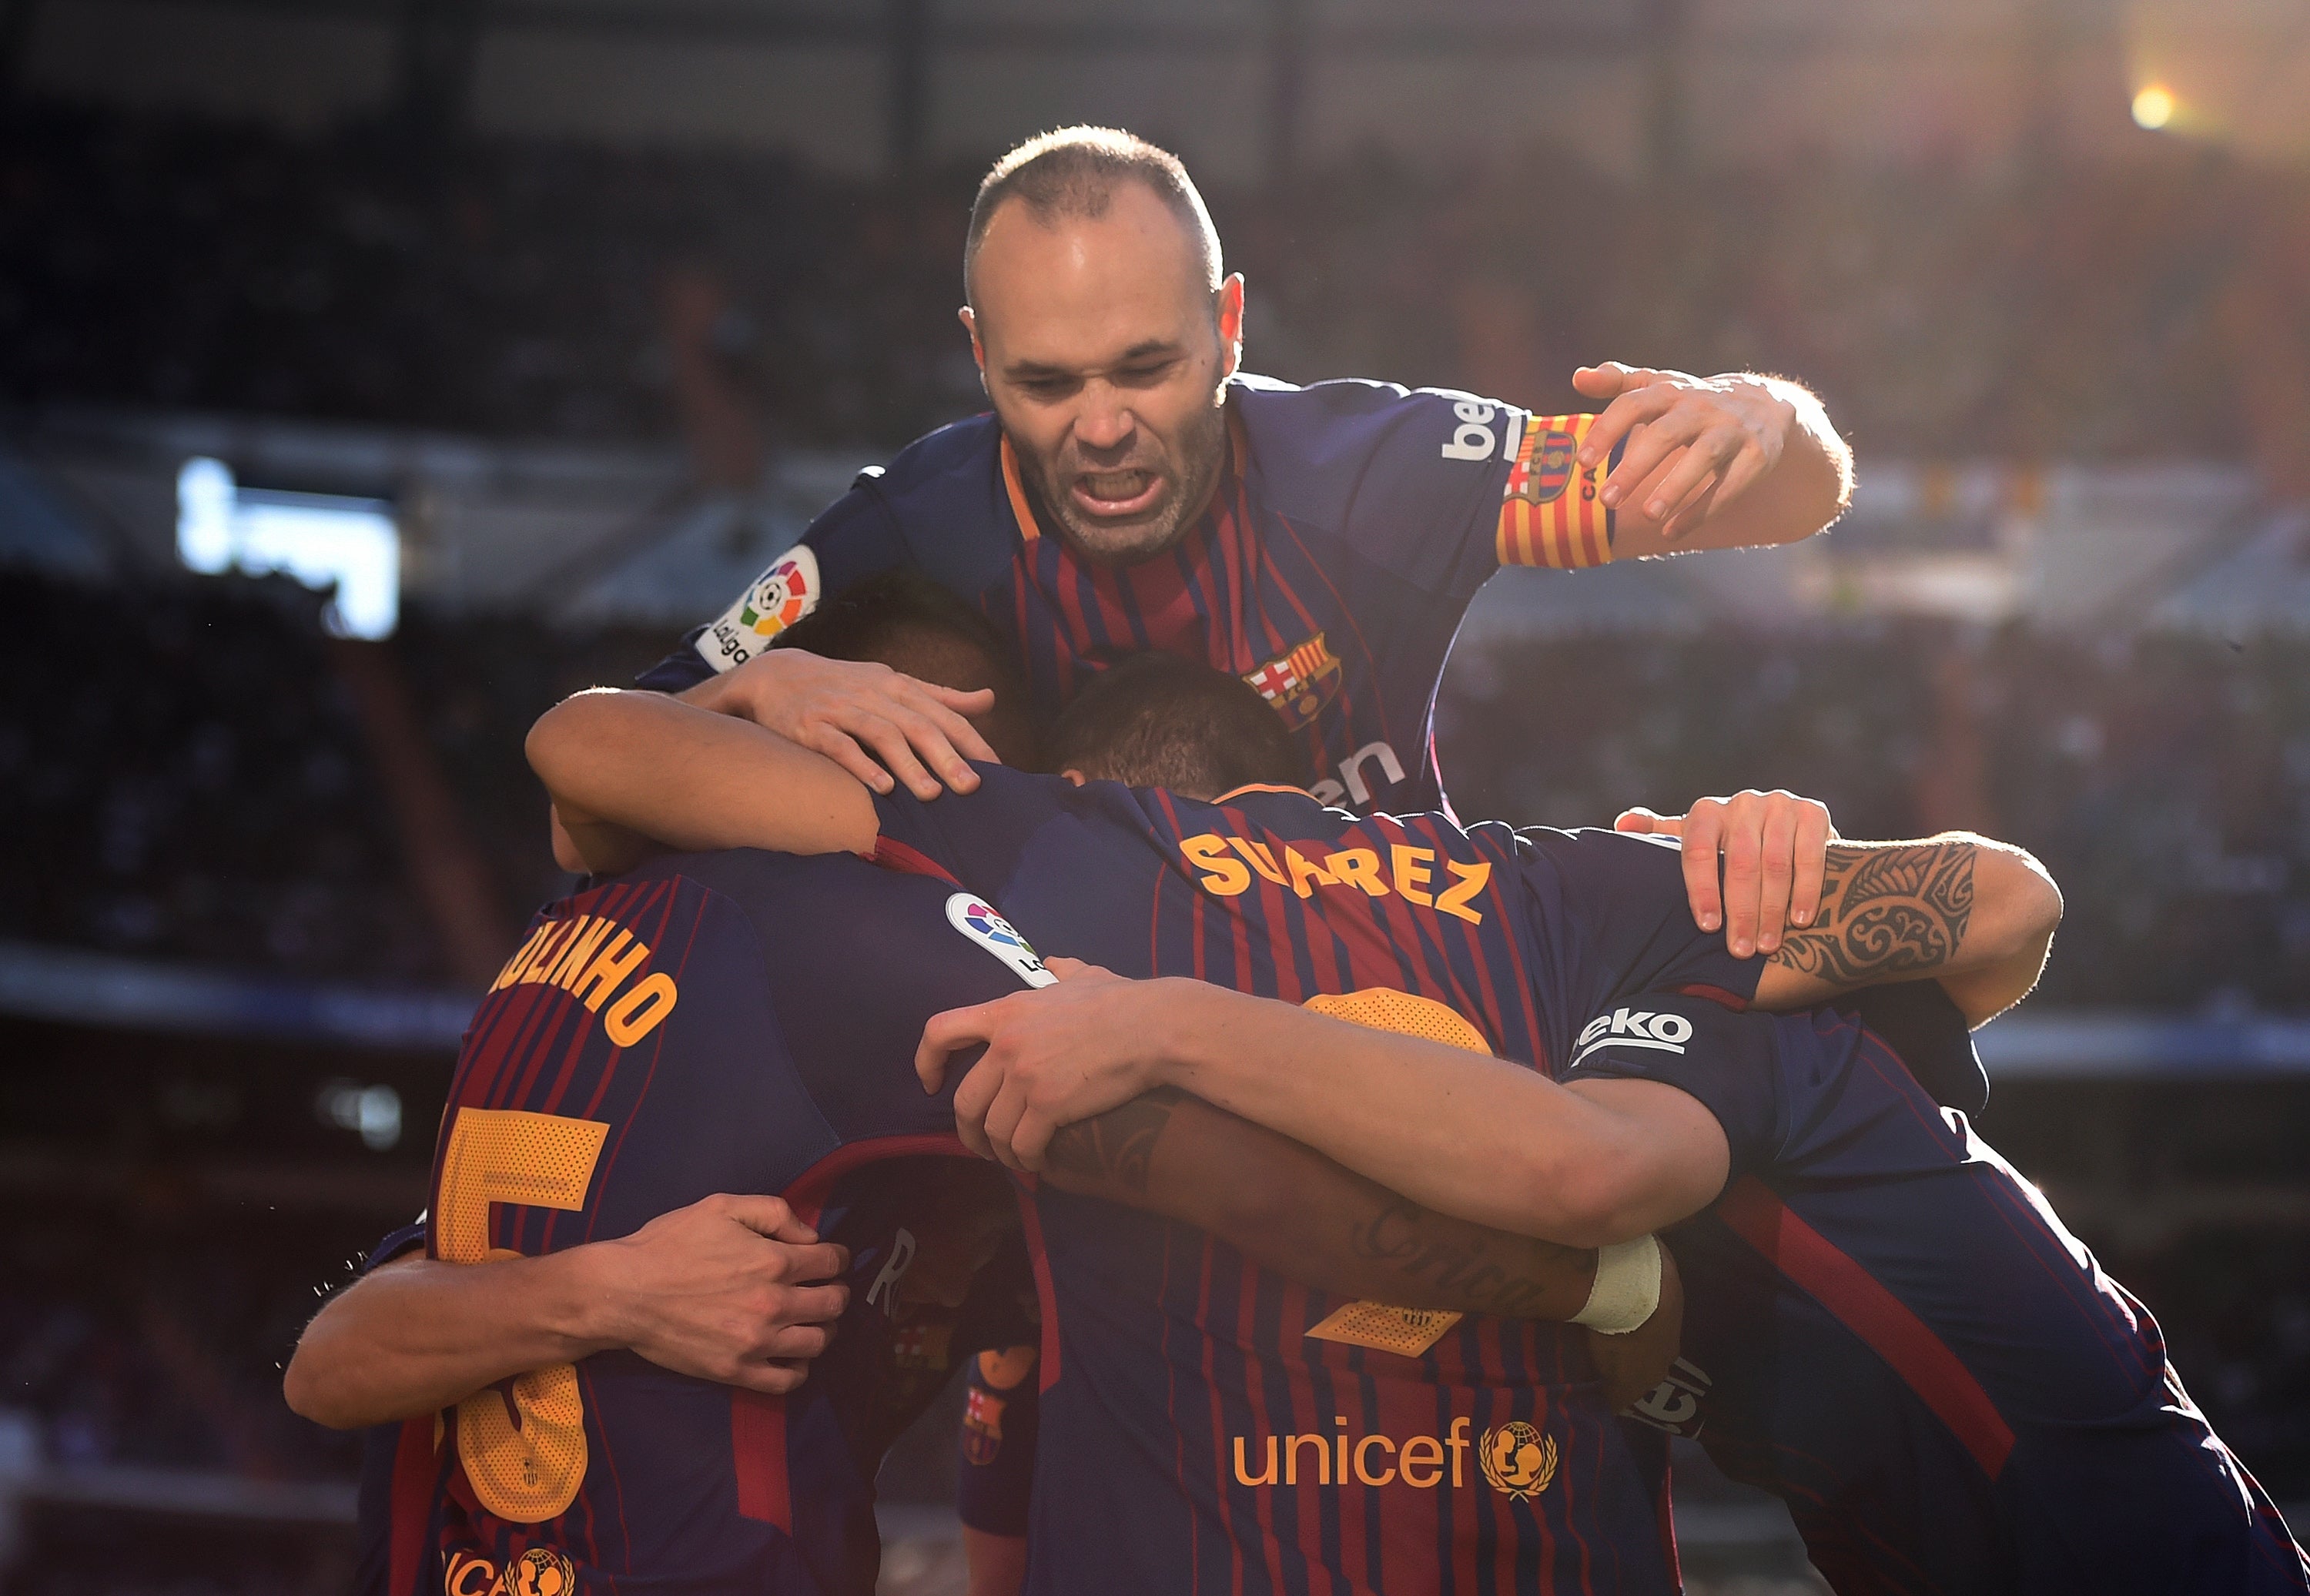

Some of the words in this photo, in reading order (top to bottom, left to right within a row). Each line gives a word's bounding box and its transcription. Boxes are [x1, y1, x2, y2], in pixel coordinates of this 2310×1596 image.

[1441, 402, 1496, 461] be
[1573, 1007, 1693, 1053] eko
[1232, 1416, 1471, 1488] unicef
